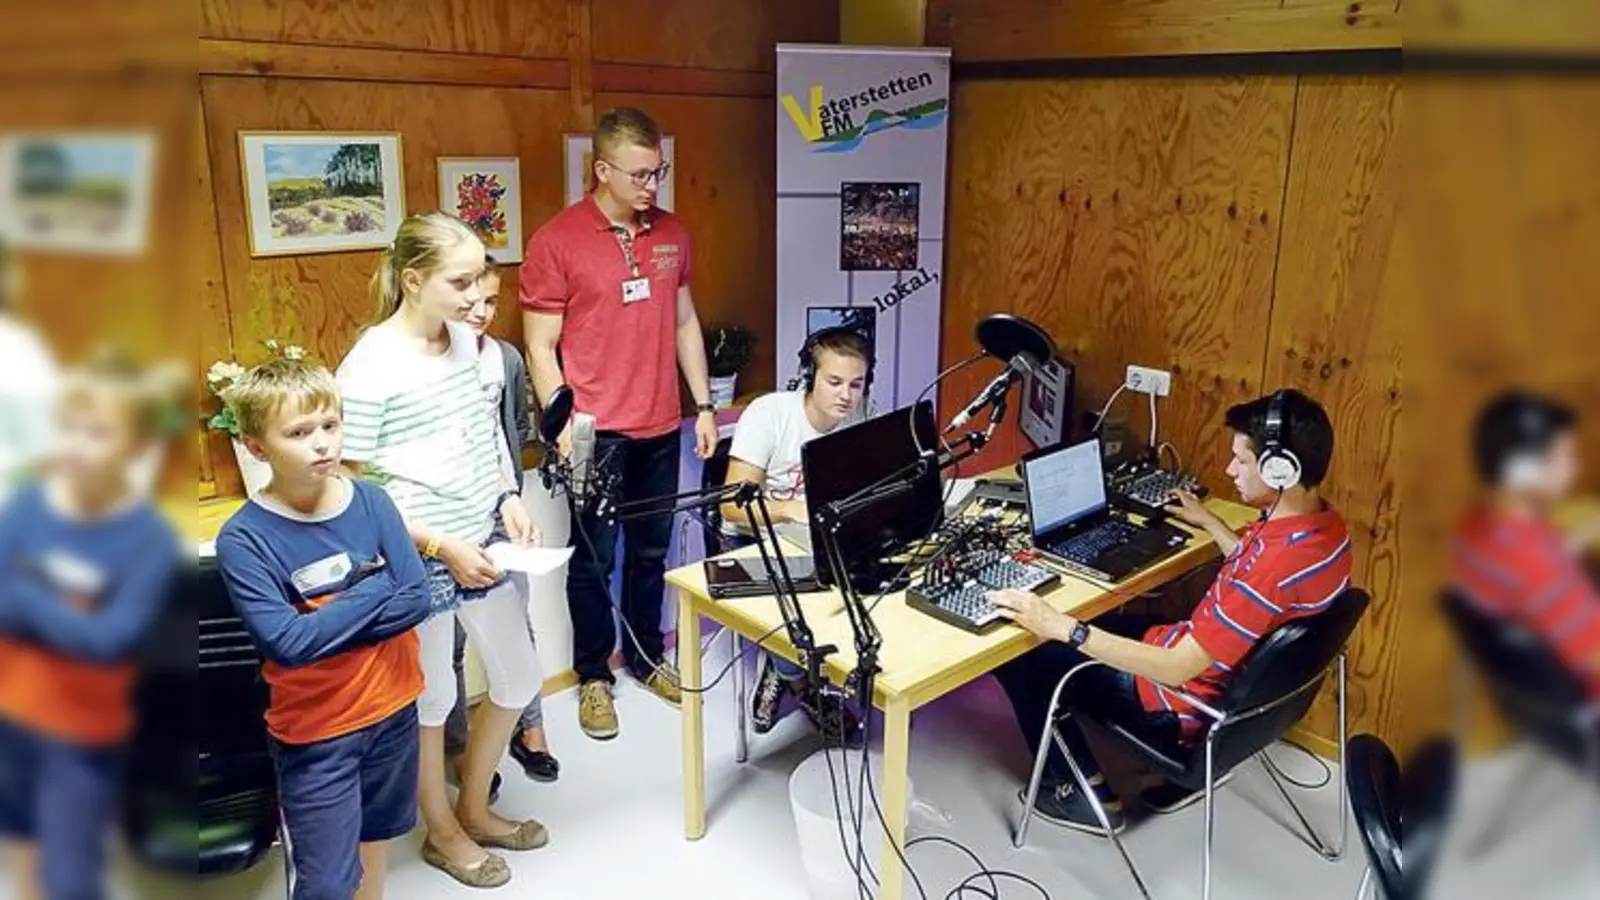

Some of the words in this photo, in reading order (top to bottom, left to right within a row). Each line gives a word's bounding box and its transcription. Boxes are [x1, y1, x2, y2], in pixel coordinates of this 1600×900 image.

[781, 72, 933, 141] Vaterstetten
[820, 113, 853, 138] FM
[873, 267, 939, 313] lokal,
